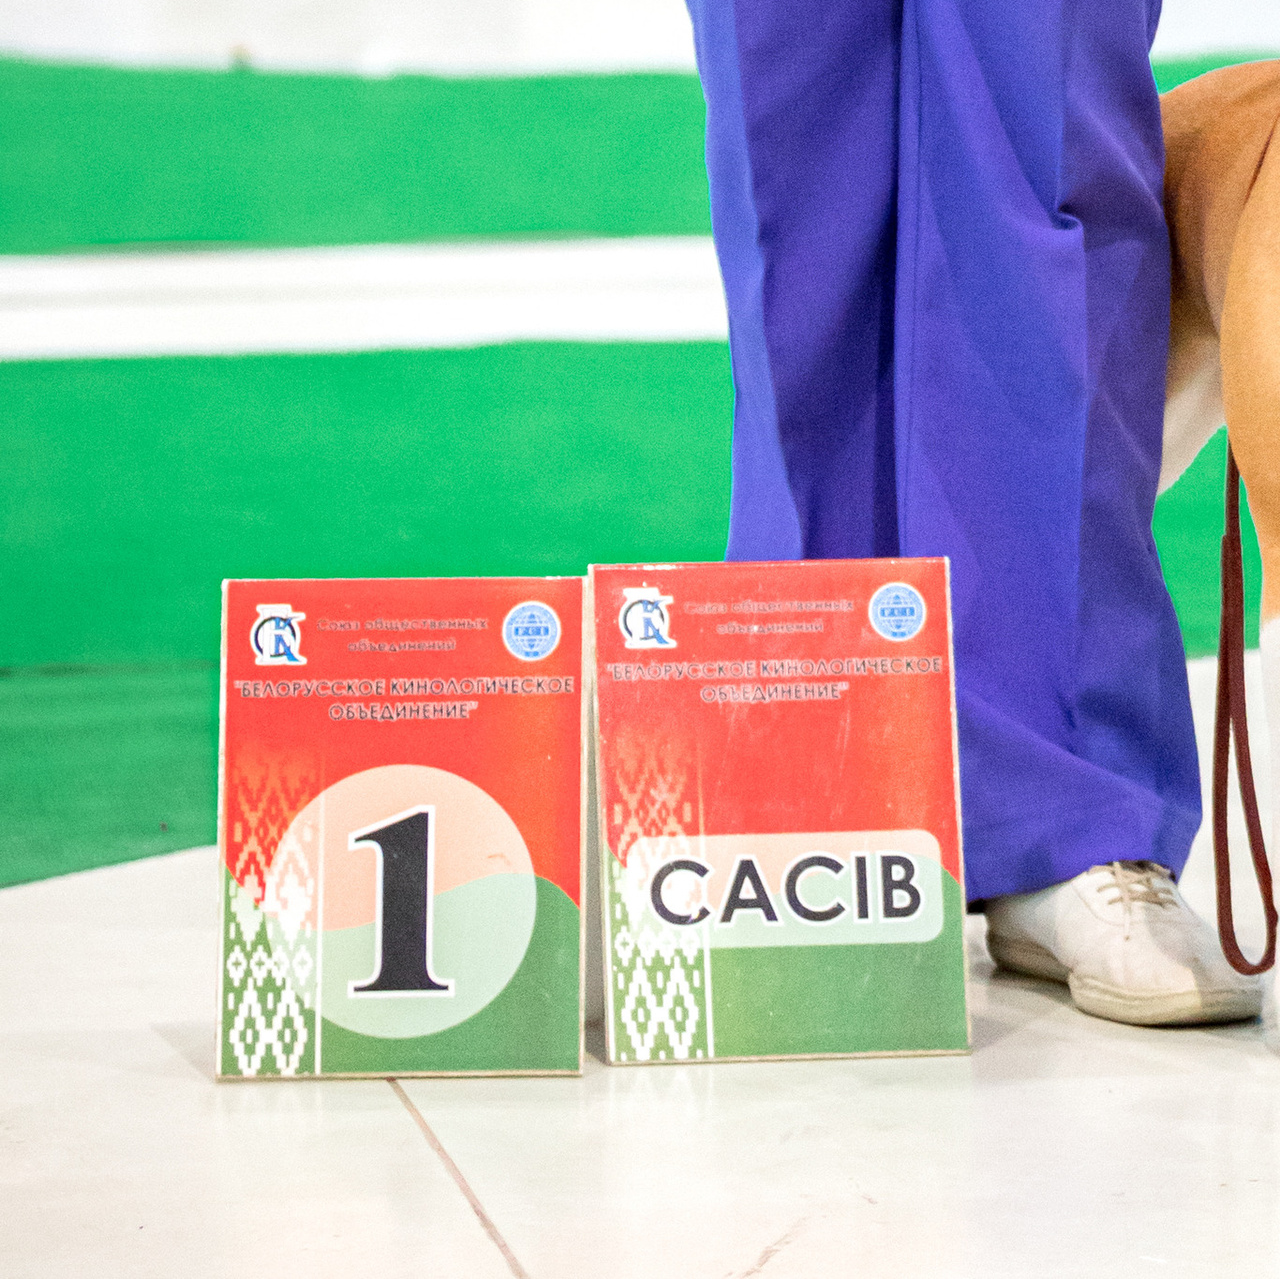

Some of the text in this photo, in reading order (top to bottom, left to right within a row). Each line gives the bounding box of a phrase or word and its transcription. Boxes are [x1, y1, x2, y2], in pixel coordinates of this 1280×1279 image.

[730, 599, 855, 614] общественных
[316, 617, 489, 632] Союз общественных
[716, 619, 824, 635] объединений
[347, 637, 457, 652] объединений
[607, 657, 943, 682] "БЕЛОРУССКОЕ КИНОЛОГИЧЕСКОЕ
[234, 676, 575, 699] "БЕЛОРУССКОЕ КИНОЛОГИЧЕСКОЕ
[701, 681, 849, 705] ОБЪЕДИНЕНИЕ"
[329, 701, 479, 722] ОБЪЕДИНЕНИЕ"
[351, 808, 452, 995] 1
[650, 855, 922, 926] CACIB
